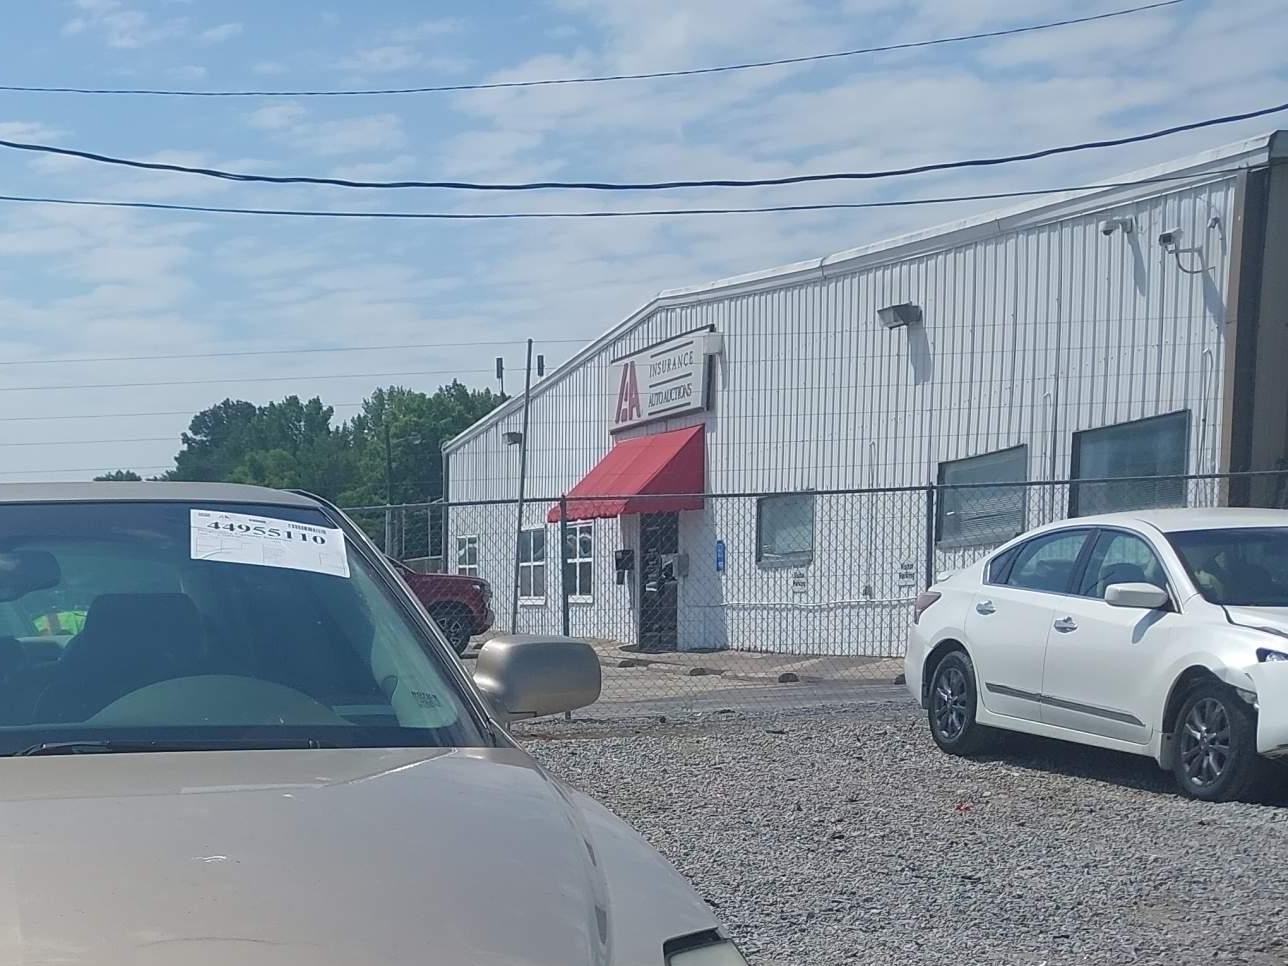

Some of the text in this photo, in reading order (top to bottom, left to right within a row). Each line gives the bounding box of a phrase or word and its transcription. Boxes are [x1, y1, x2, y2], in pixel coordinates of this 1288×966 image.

[649, 351, 693, 378] INSURANCE
[648, 383, 692, 408] AUTO AUCTIONS
[207, 521, 326, 545] 44955110
